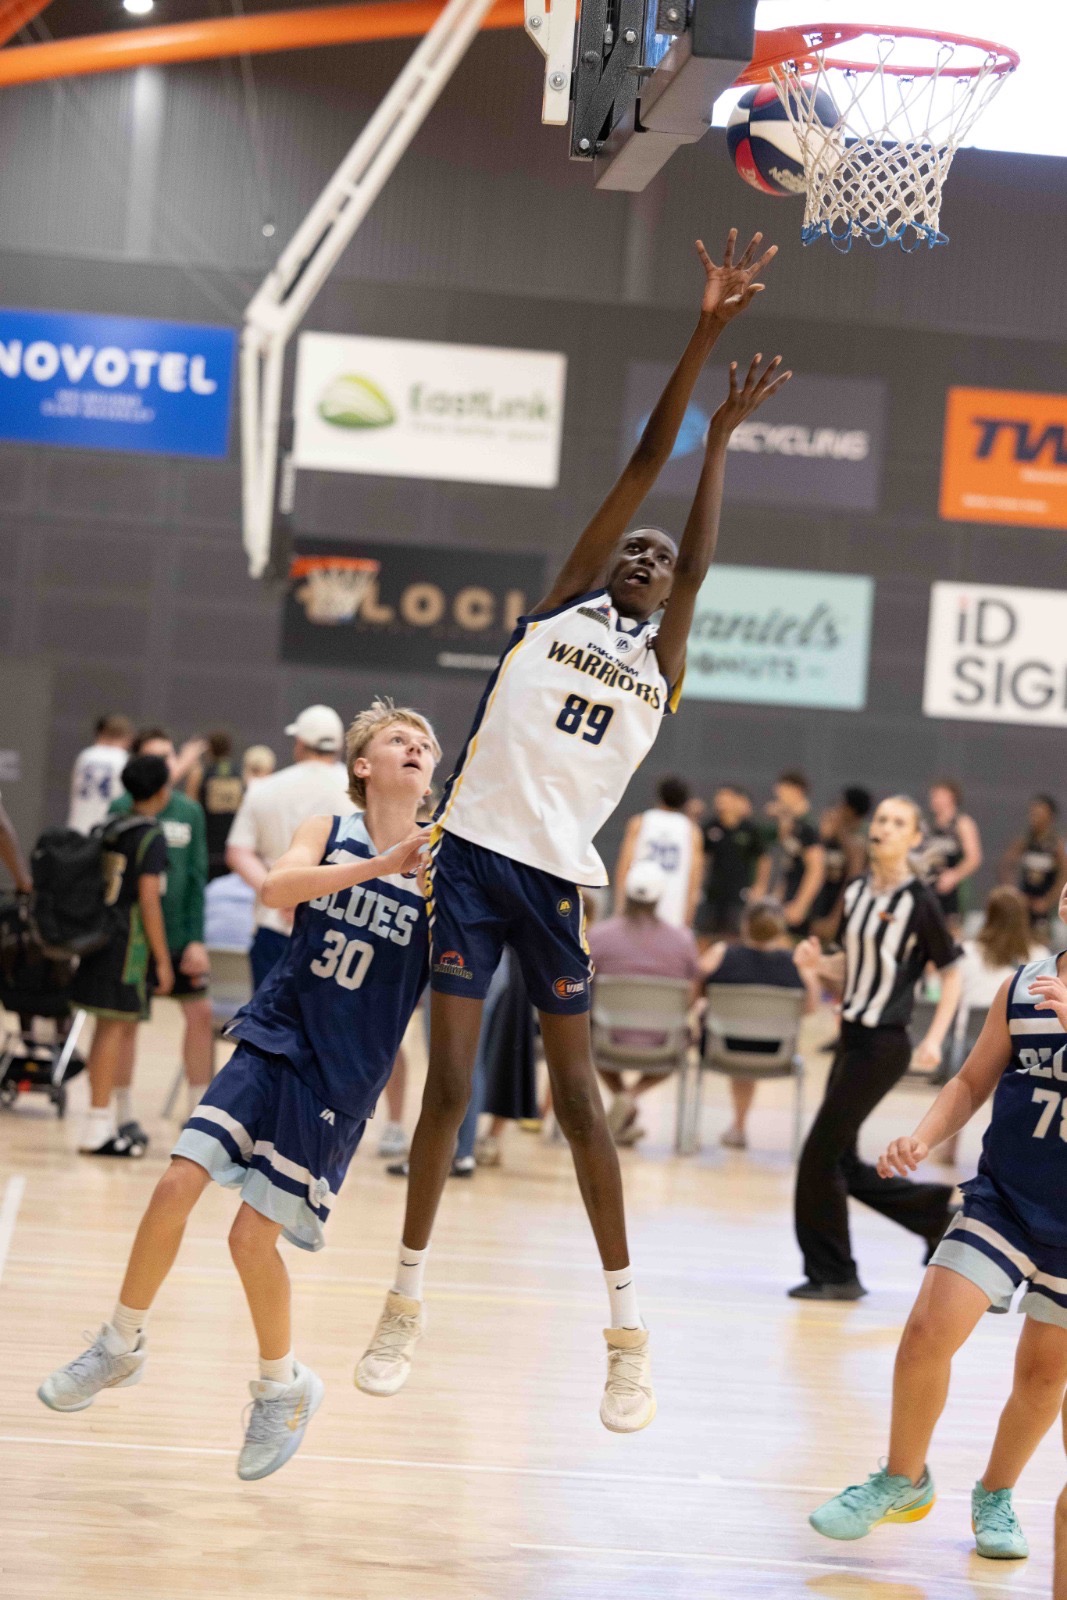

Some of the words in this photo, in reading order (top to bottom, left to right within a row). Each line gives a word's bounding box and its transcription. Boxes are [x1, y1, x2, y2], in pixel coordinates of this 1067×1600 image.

[0, 339, 218, 395] NOVOTEL
[547, 641, 661, 709] WARRIORS
[953, 656, 1067, 712] SIG
[554, 693, 615, 745] 89
[309, 928, 375, 990] 30
